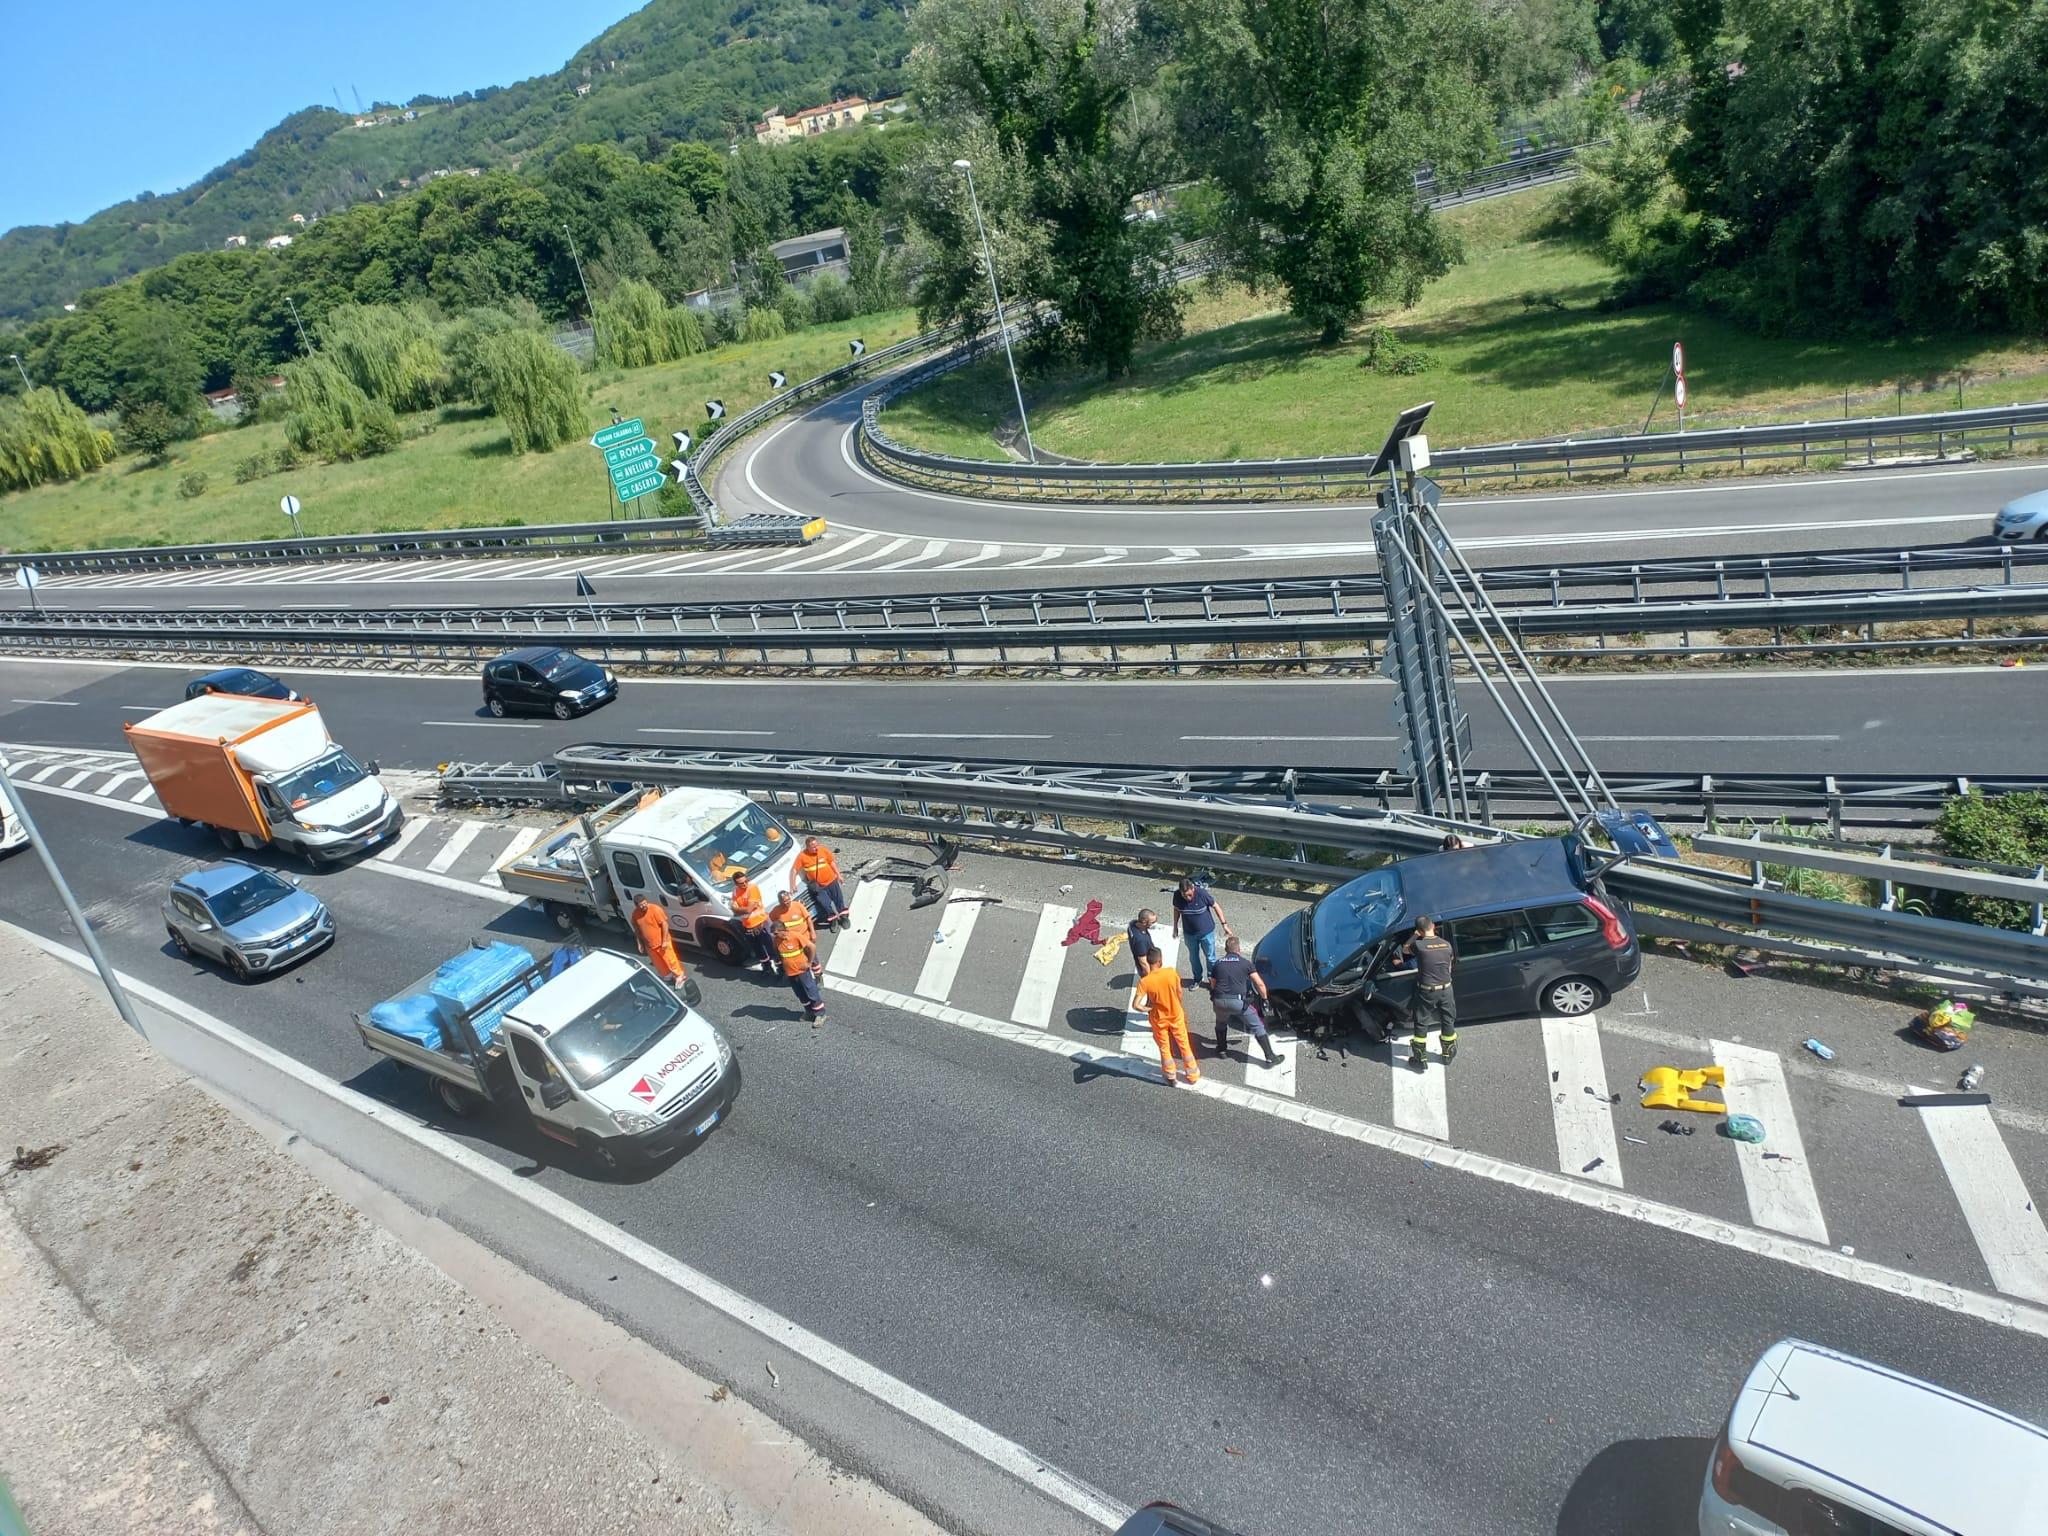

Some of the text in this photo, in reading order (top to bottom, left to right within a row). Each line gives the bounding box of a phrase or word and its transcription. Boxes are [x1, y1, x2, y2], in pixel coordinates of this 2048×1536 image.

[619, 443, 646, 459] ROMA
[624, 460, 653, 477] AVELLINO
[631, 477, 657, 493] CASERTA
[657, 1043, 700, 1079] MONZILLO
